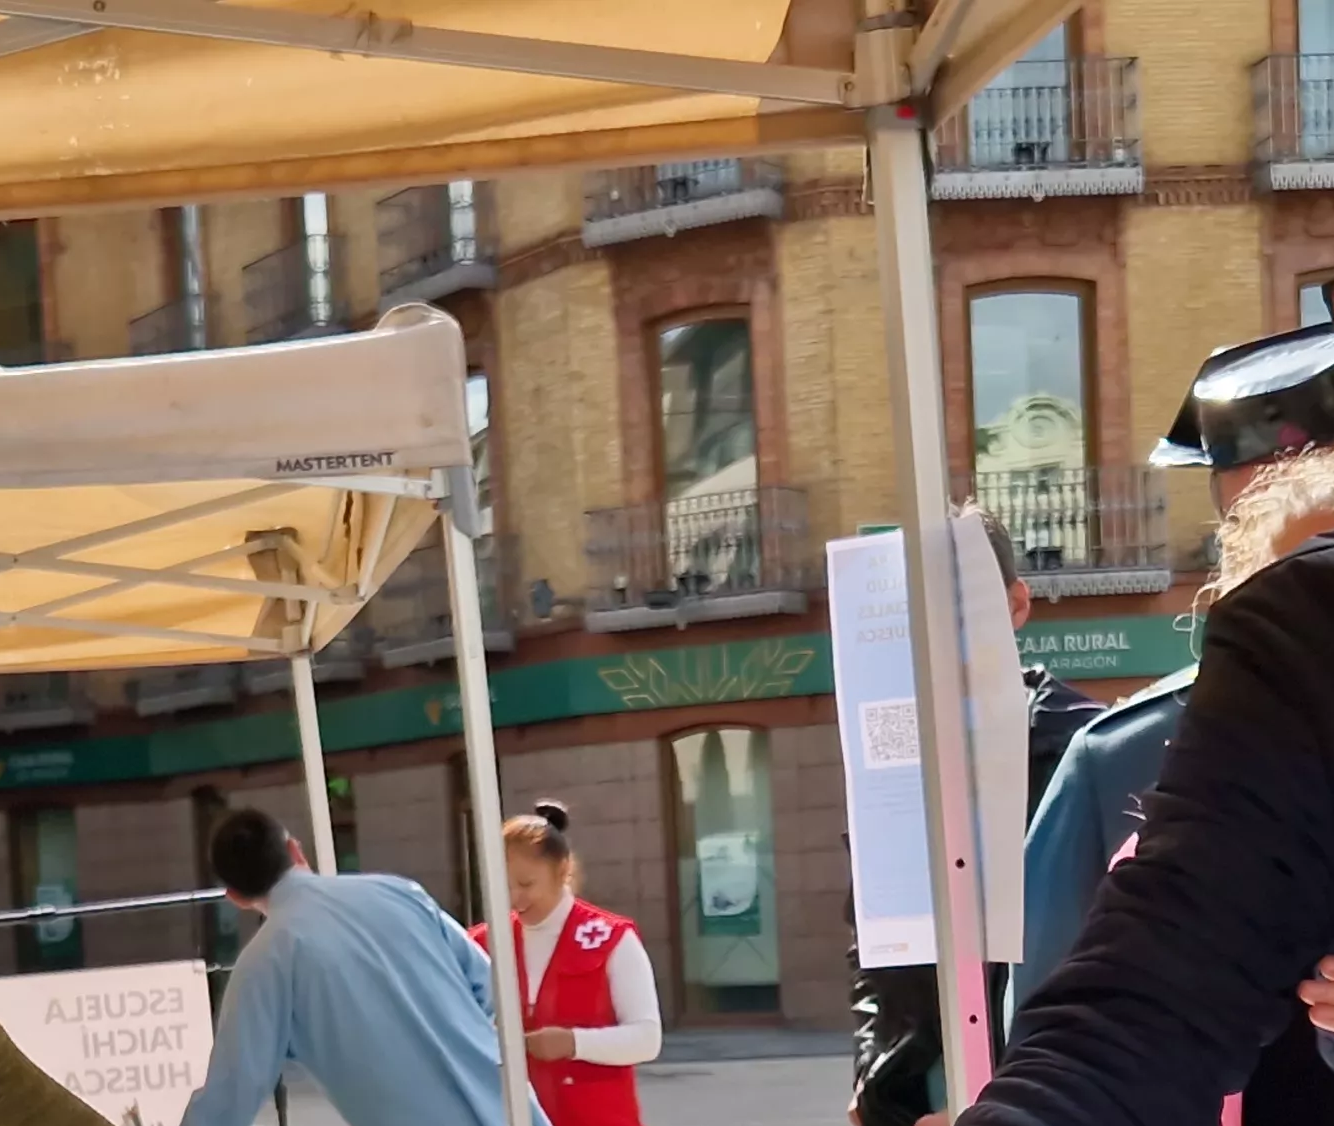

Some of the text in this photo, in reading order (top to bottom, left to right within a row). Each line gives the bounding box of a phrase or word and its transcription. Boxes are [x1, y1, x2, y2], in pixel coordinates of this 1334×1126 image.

[275, 451, 394, 473] MASTERTENT
[1064, 632, 1131, 651] RURAL
[1049, 654, 1119, 670] ARAGÓN
